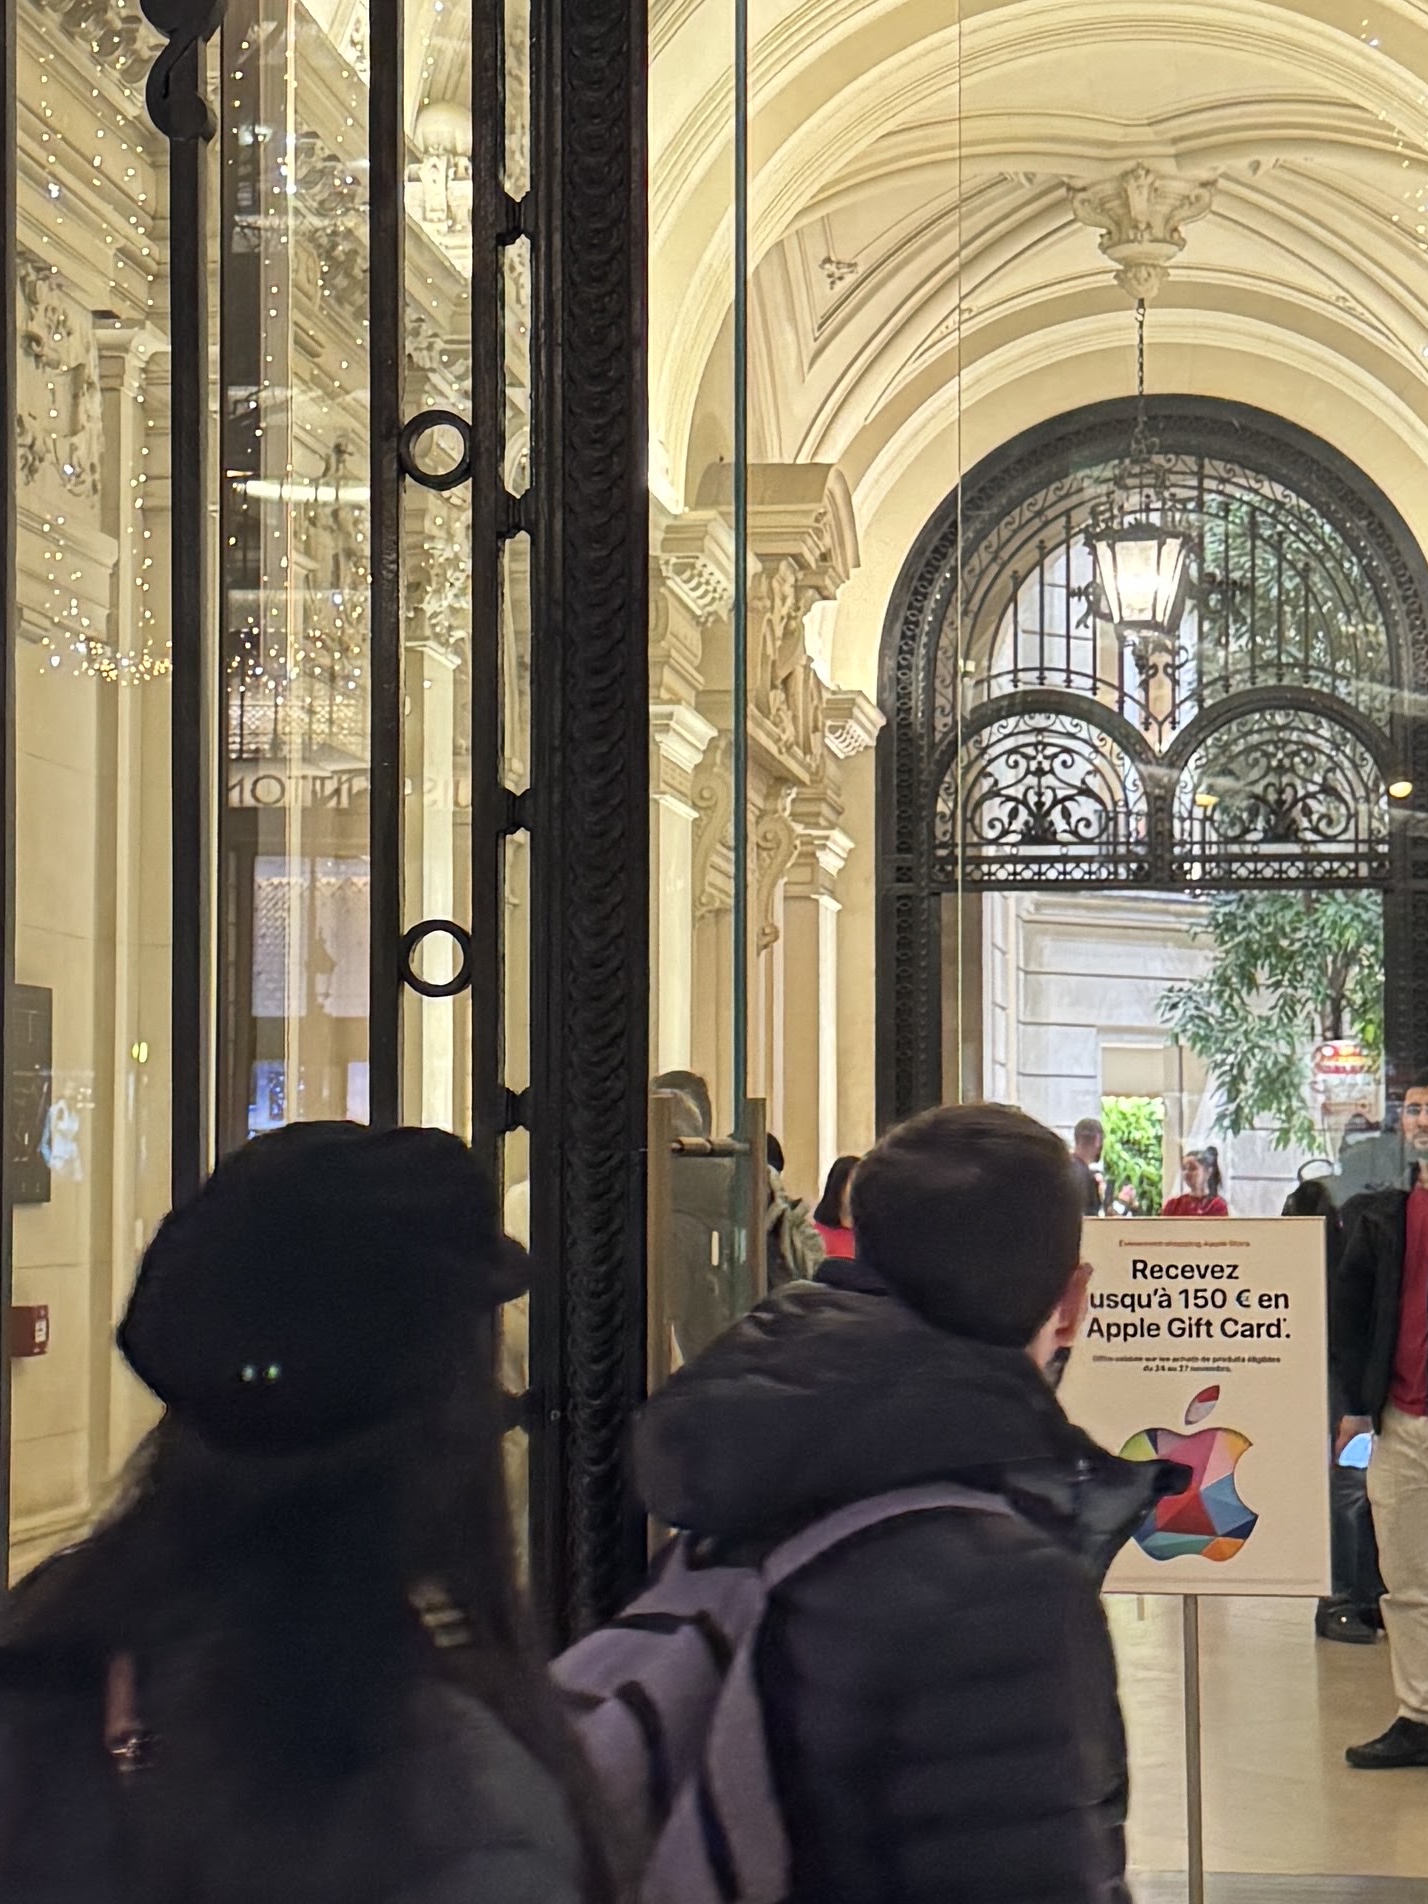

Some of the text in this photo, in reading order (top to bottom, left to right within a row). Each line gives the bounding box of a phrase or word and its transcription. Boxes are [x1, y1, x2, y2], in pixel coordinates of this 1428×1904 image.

[1131, 1258, 1240, 1281] Recevez
[1089, 1287, 1290, 1313] usqu'à 150 € en
[1086, 1316, 1161, 1343] Apple
[1167, 1316, 1214, 1339] Gift
